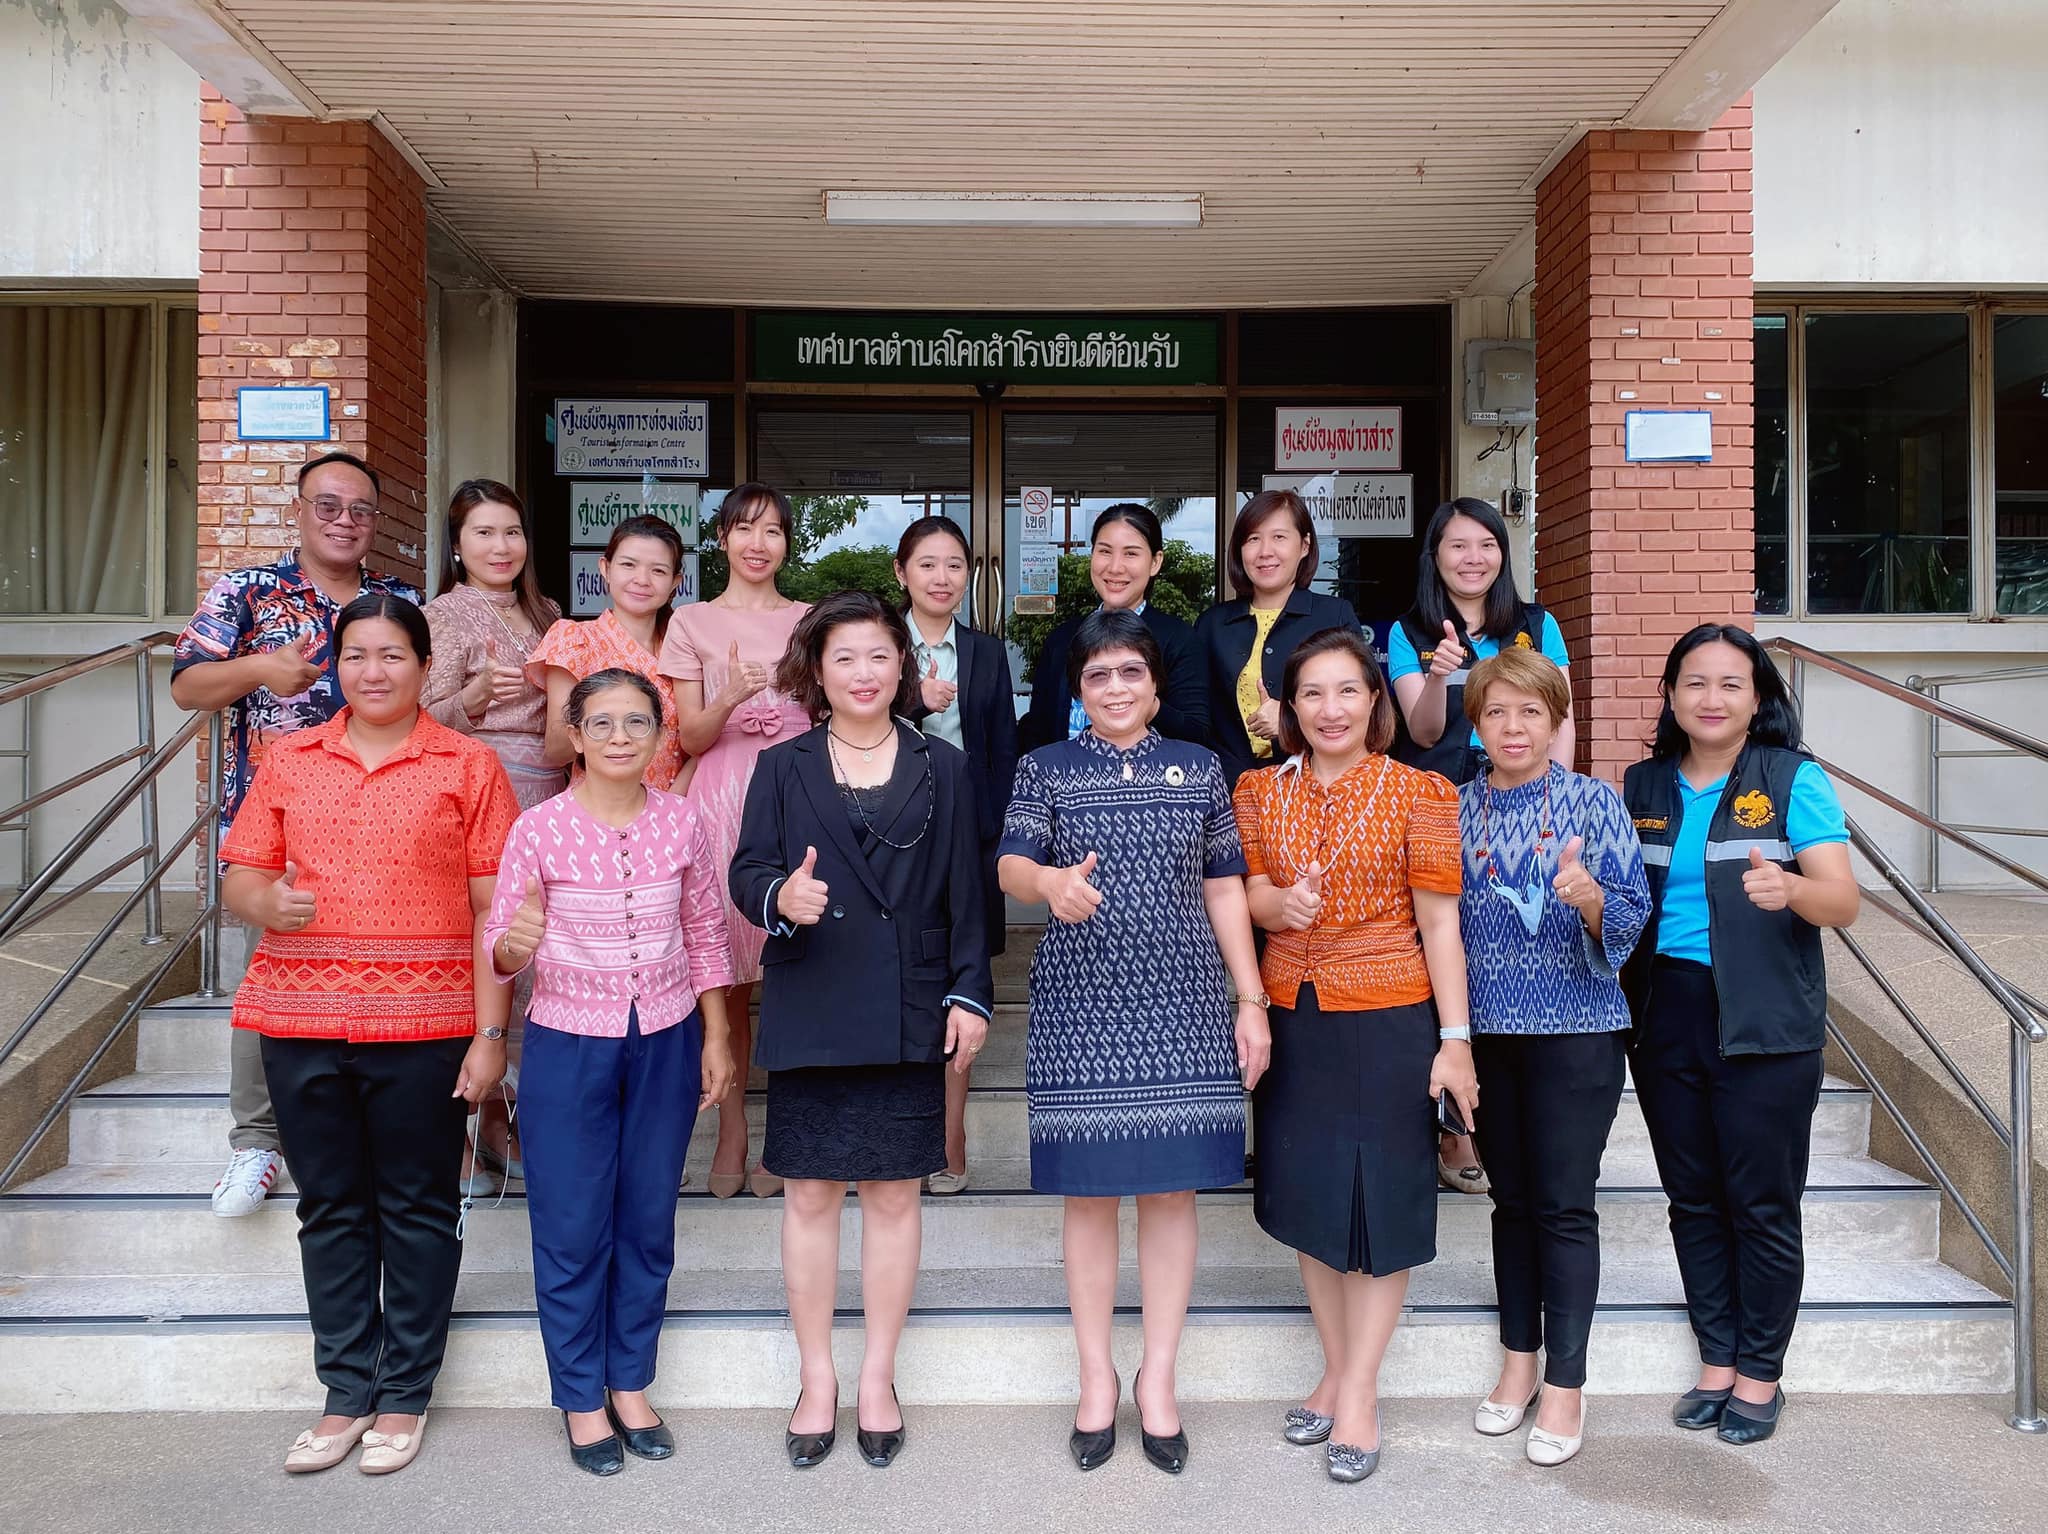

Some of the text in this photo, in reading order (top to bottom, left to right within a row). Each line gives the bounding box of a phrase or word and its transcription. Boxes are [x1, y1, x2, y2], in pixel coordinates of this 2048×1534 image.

[797, 328, 1181, 368] เทศบาลตำบลโคกสำโรงยินดีต้อนรับ
[561, 405, 704, 435] ศูนย์ข้อมูลการท่องเที่ยว
[580, 436, 609, 447] Tourist
[661, 437, 686, 448] Centre
[1282, 416, 1395, 460] ศูนย์ข้อมูลข่าวสาร
[588, 455, 700, 469] เทศบาลตำบลโคกสำโรง
[1025, 515, 1047, 529] เขต
